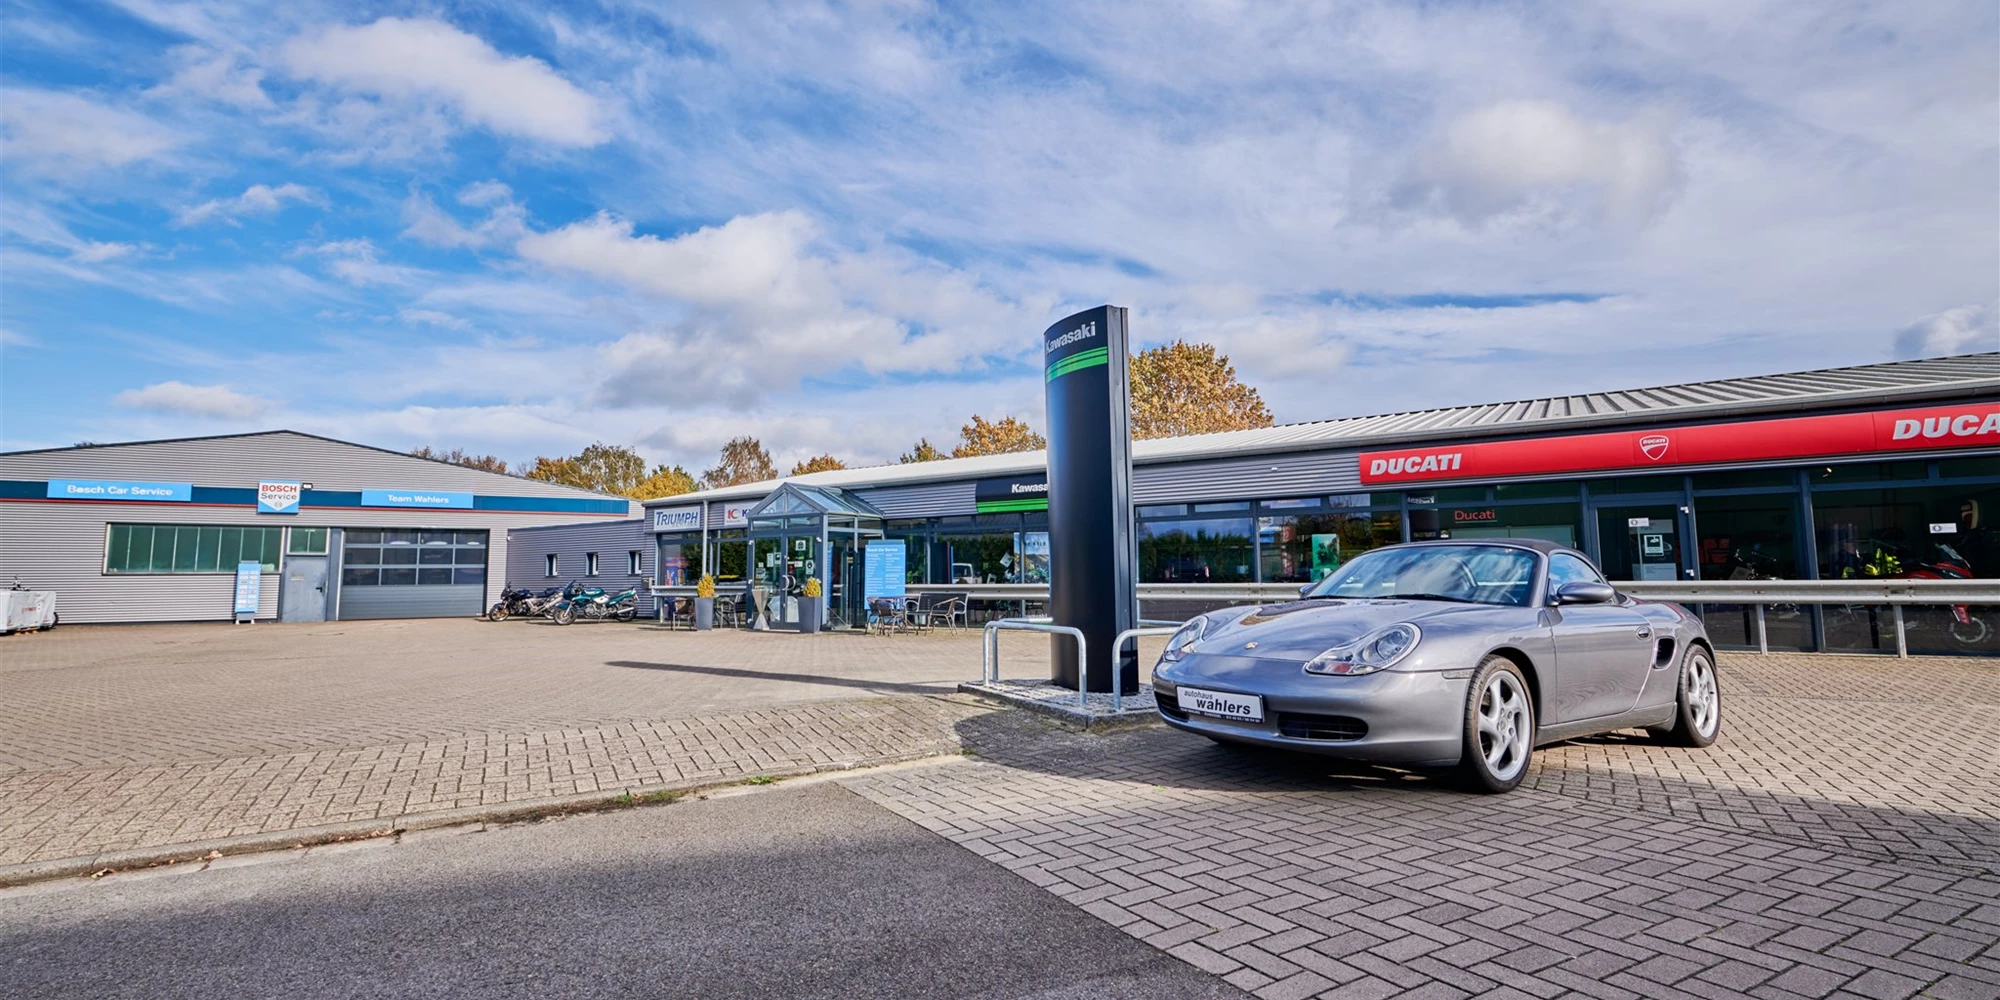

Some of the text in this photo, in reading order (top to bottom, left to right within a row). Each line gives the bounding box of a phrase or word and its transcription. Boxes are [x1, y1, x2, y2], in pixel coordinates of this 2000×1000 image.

[1045, 321, 1096, 353] Kawasaki
[1370, 453, 1461, 476] DUCATI
[67, 485, 173, 496] Bosch Car Service
[262, 485, 297, 493] BOSCH
[261, 492, 297, 500] Service
[388, 494, 449, 503] Team Wahlers
[656, 511, 698, 526] TRIUMPH
[1454, 509, 1495, 520] Ducati
[1184, 690, 1213, 699] autohaus
[1196, 698, 1251, 715] wahlers
